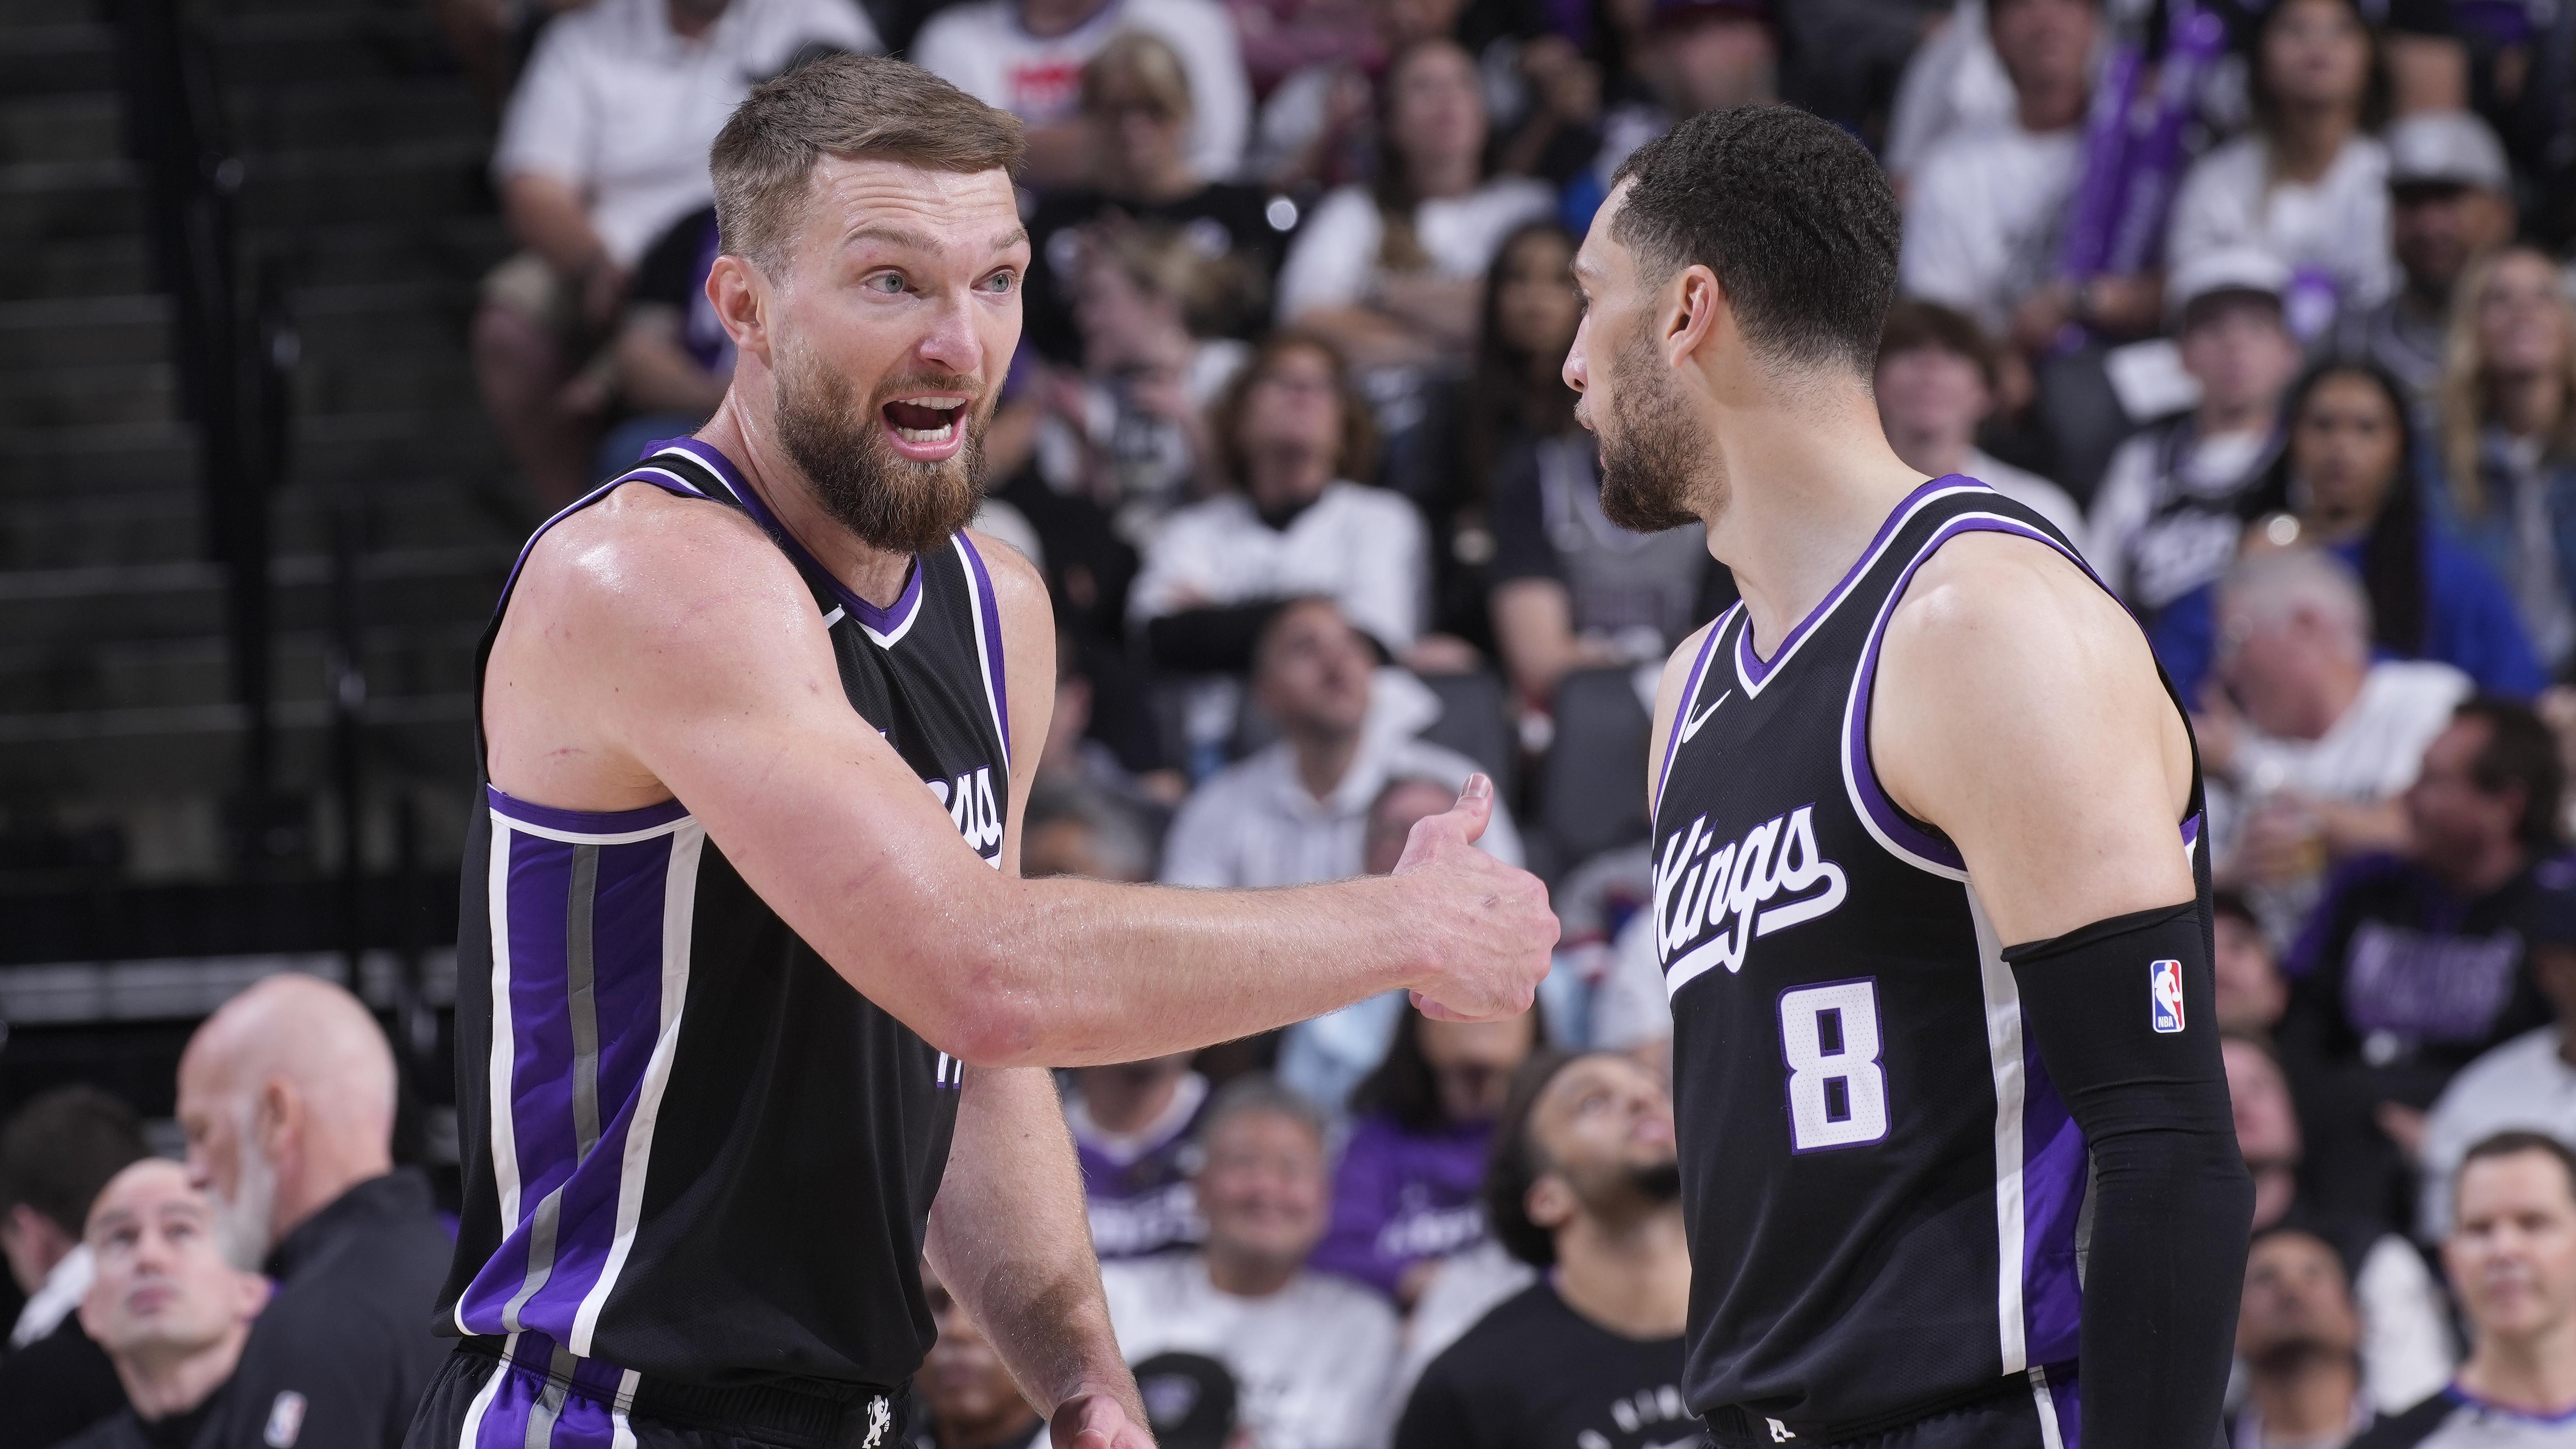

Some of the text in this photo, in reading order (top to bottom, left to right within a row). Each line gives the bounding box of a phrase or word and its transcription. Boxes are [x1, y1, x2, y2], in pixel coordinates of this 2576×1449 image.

[1651, 802, 1851, 1003] Kings
[1776, 975, 1892, 1156] 8
[2158, 1015, 2174, 1029] NBA
